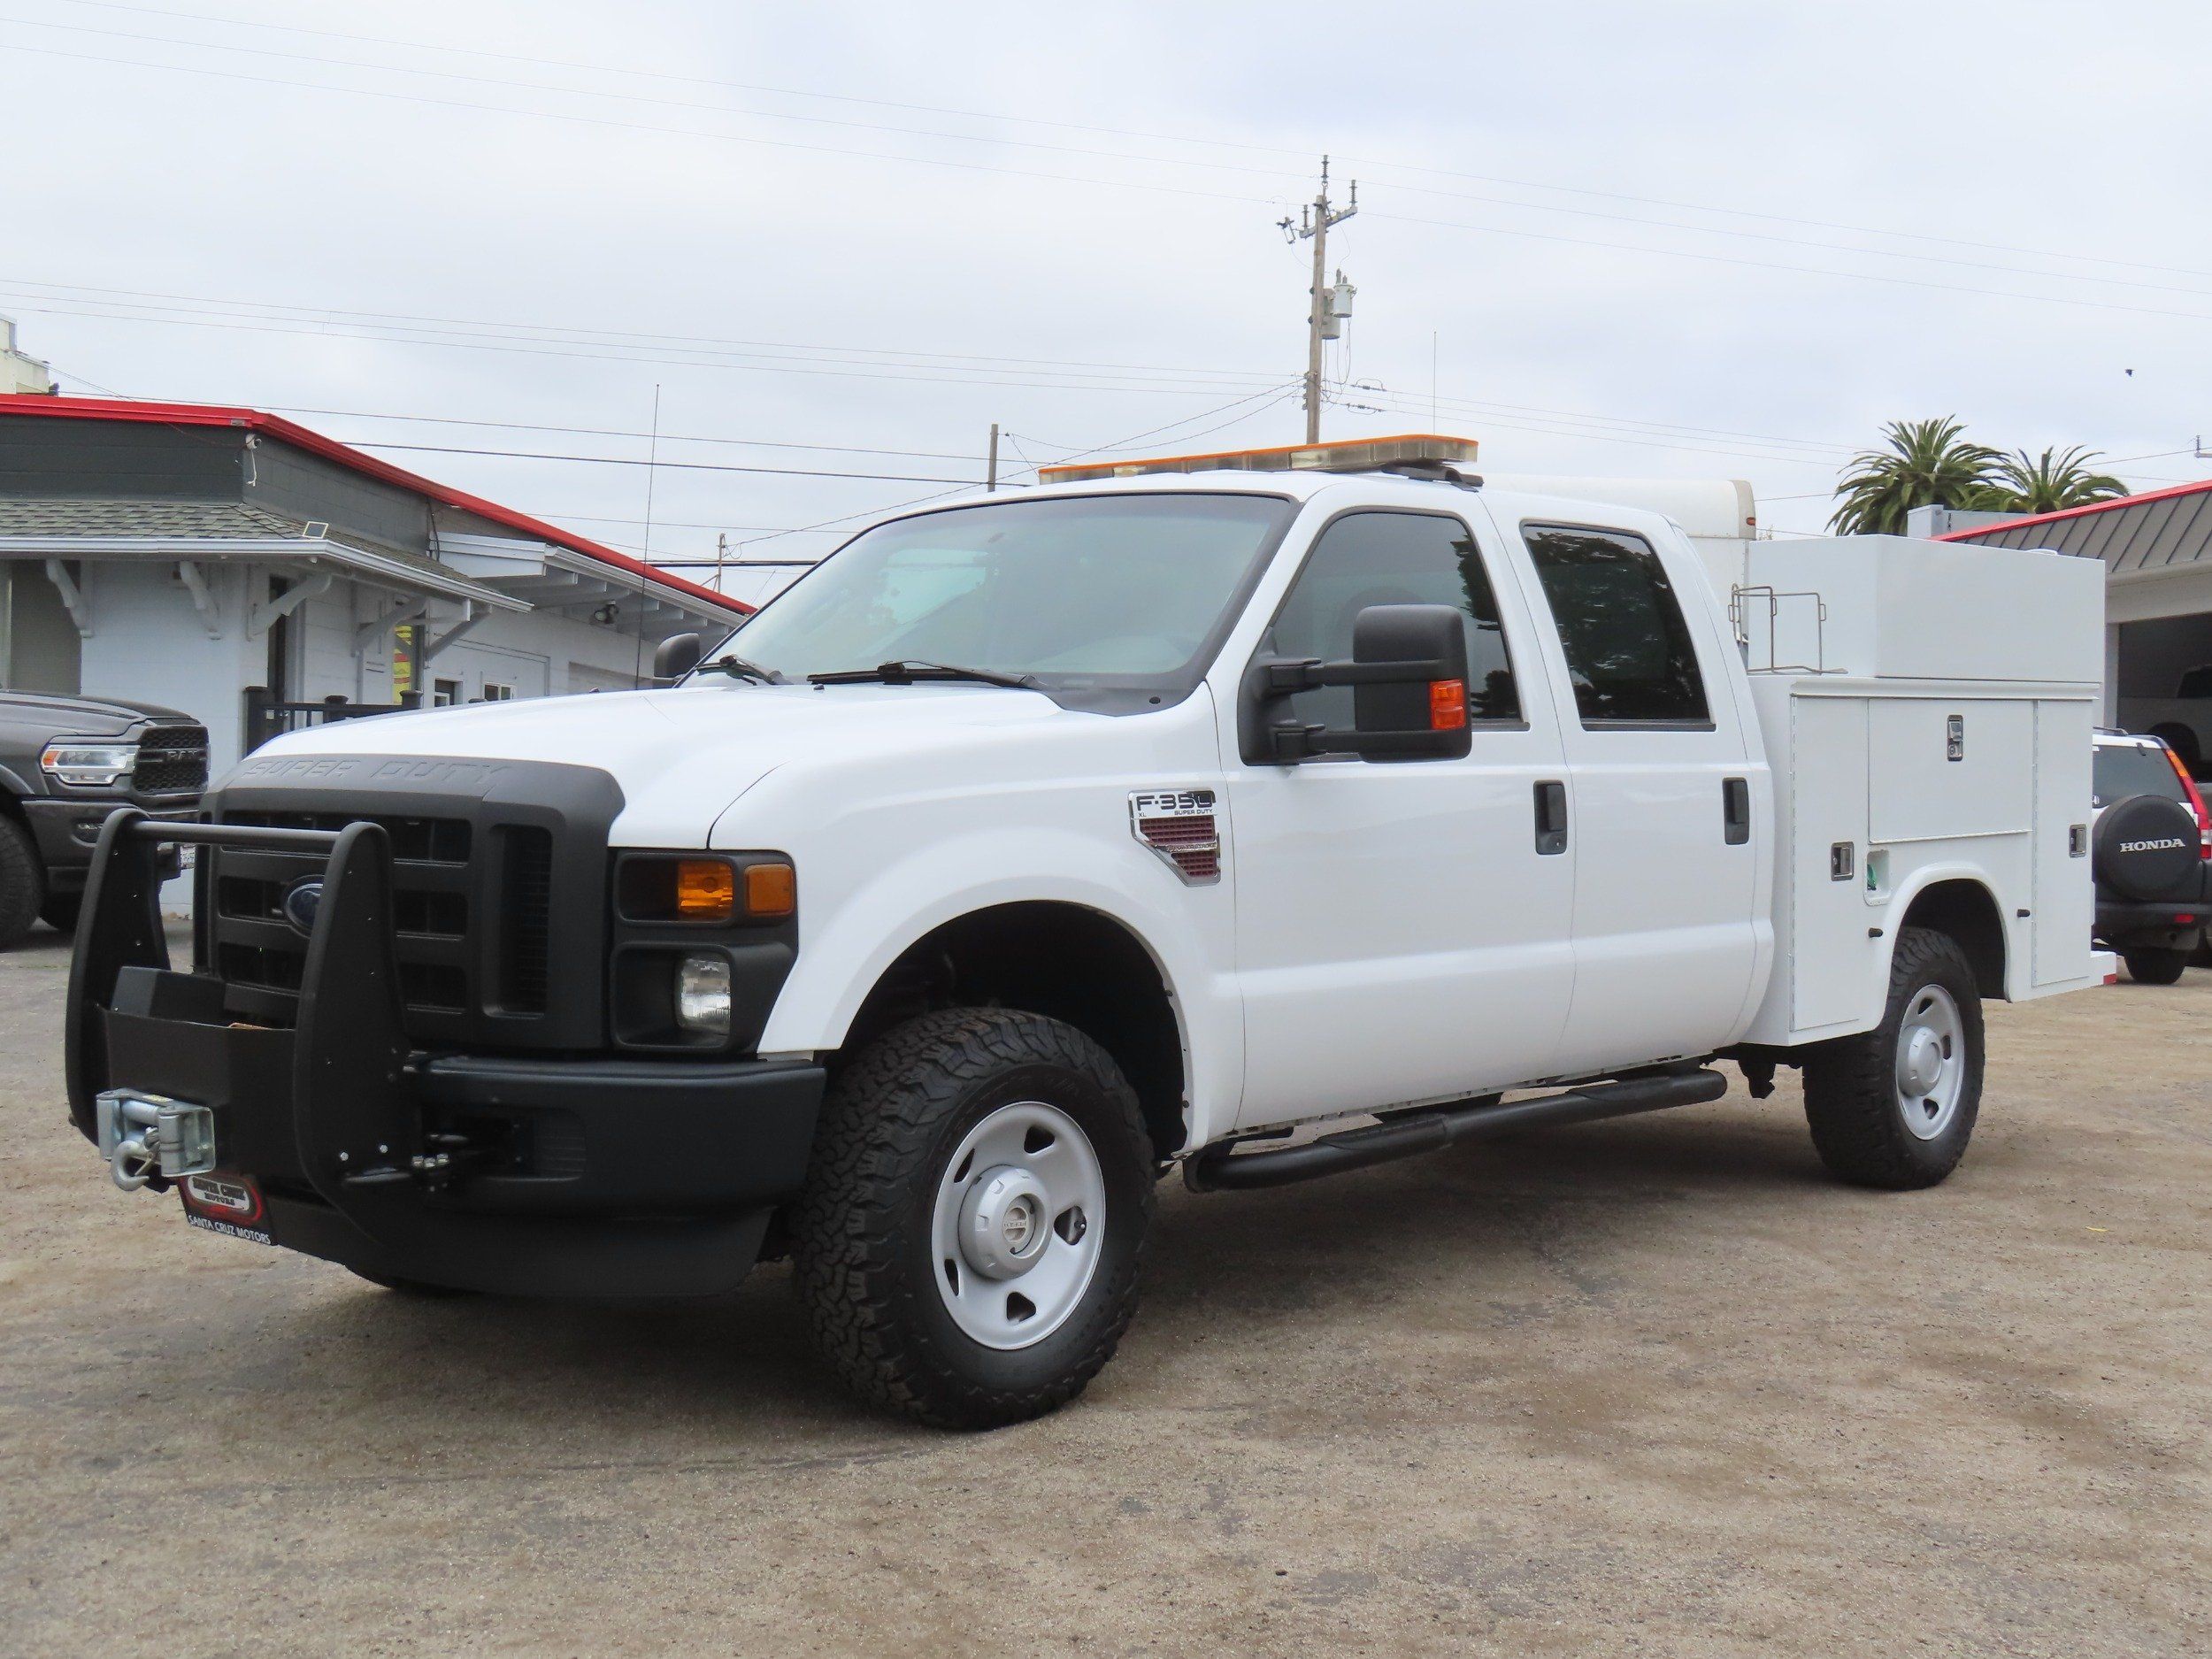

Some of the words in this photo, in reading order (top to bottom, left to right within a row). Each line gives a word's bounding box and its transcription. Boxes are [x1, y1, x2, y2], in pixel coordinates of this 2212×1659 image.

[241, 759, 361, 779] SUPER
[369, 761, 512, 784] DUTY
[2119, 838, 2186, 853] HONDA
[188, 1215, 214, 1231] SANTA
[214, 1221, 236, 1236] CRUZ
[236, 1226, 272, 1245] MOTORS
